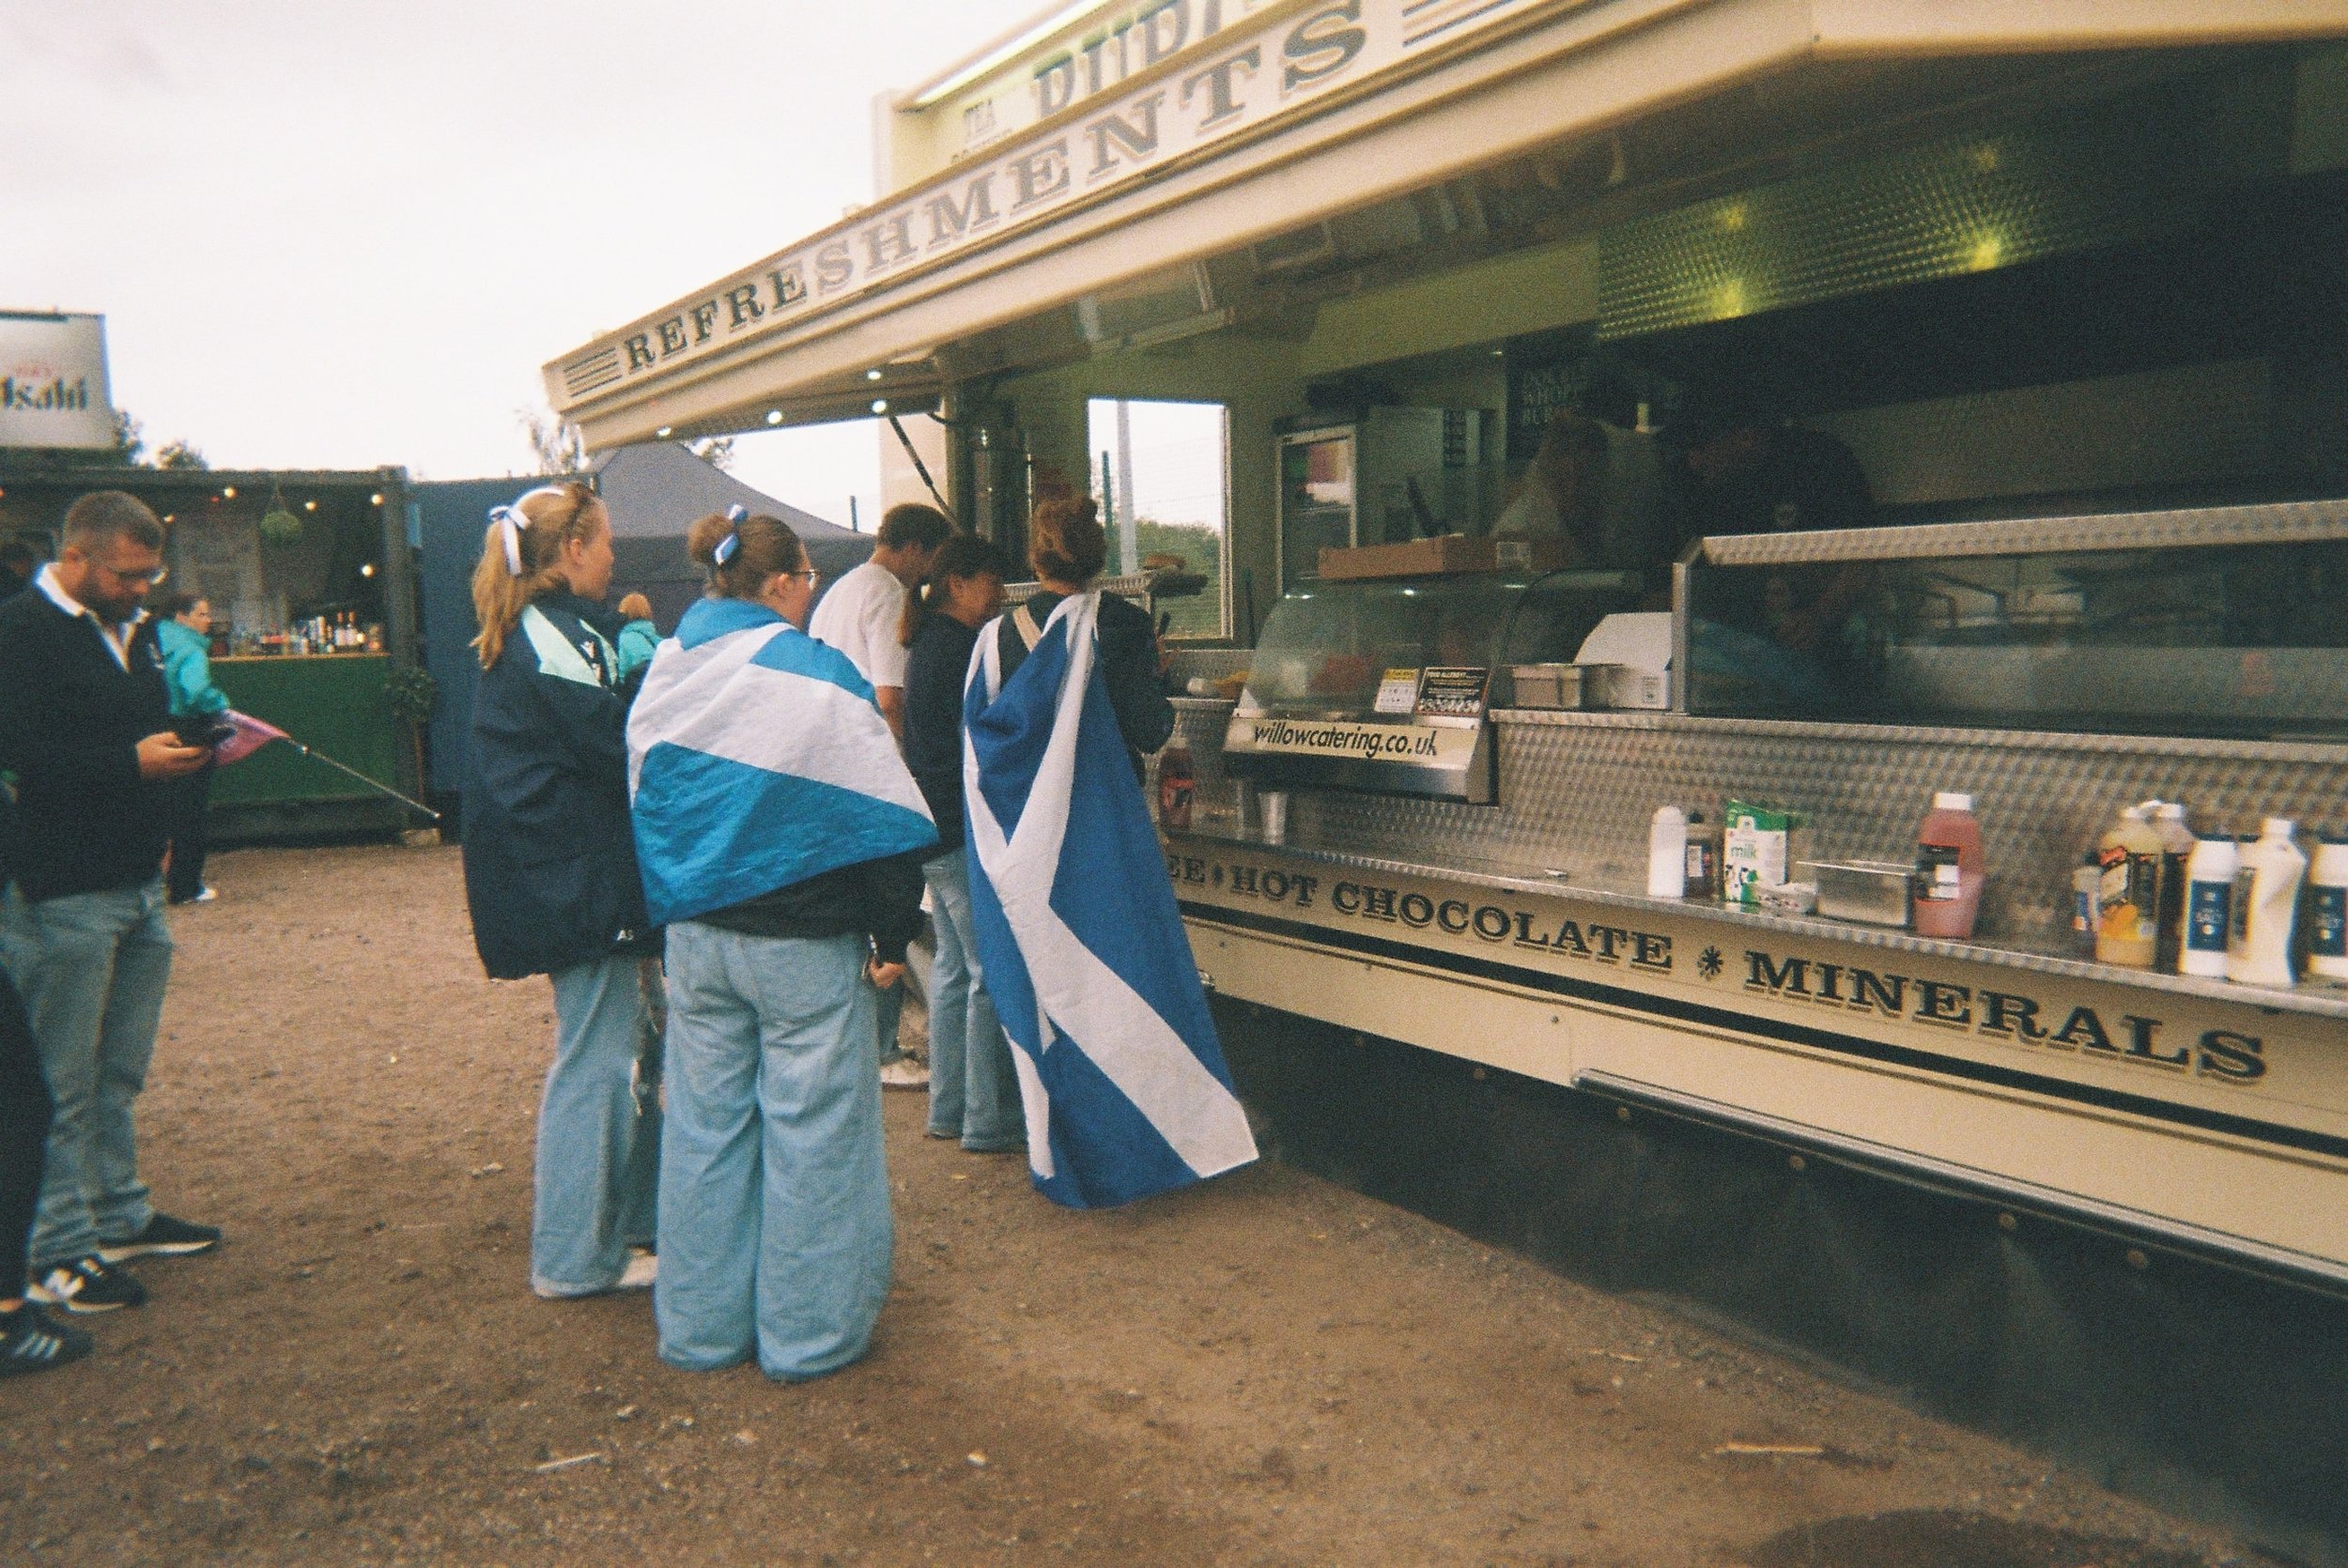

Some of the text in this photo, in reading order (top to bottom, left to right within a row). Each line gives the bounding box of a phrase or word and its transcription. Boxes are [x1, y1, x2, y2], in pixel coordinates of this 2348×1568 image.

[624, 0, 1367, 376] REFRESHMENTS
[1254, 725, 1437, 758] willowcatering.co.uk
[1230, 865, 1318, 908] HOT
[1332, 881, 1673, 974] CHOCOLATE
[1745, 950, 2267, 1085] MINERALS
